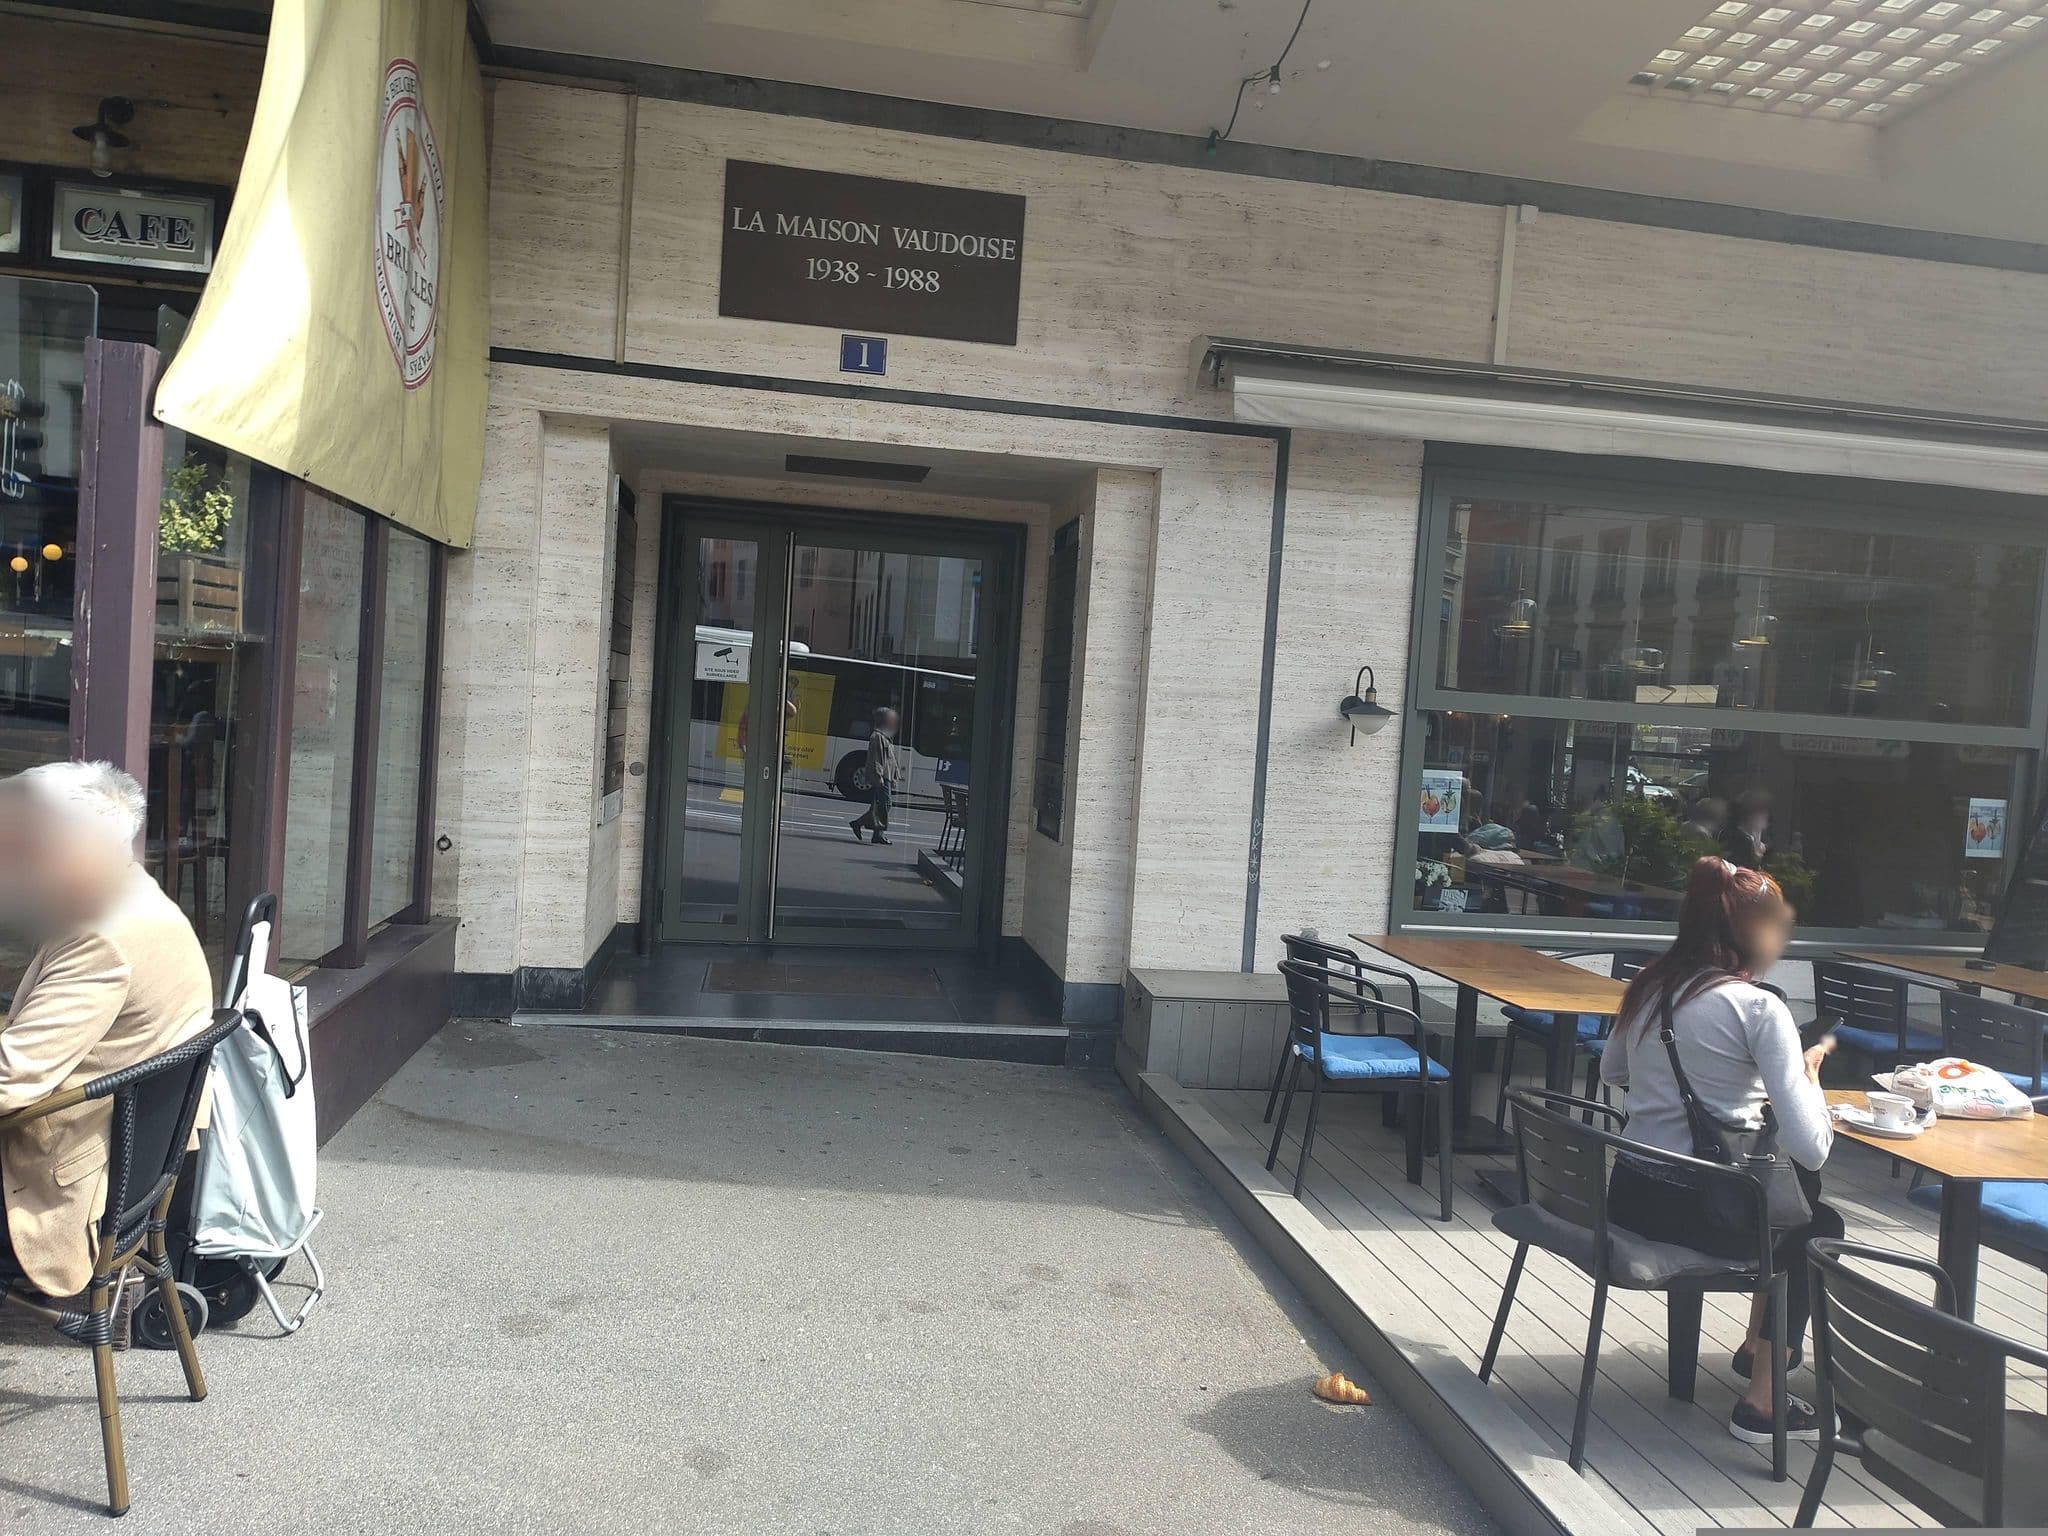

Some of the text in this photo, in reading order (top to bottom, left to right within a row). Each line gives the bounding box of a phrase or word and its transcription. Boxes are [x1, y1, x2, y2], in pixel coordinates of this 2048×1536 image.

[74, 207, 194, 252] CAFE
[732, 206, 1017, 260] LA MAISON VAUDOISE
[805, 258, 860, 284] 1938
[882, 266, 941, 293] 1988
[858, 342, 870, 368] 1
